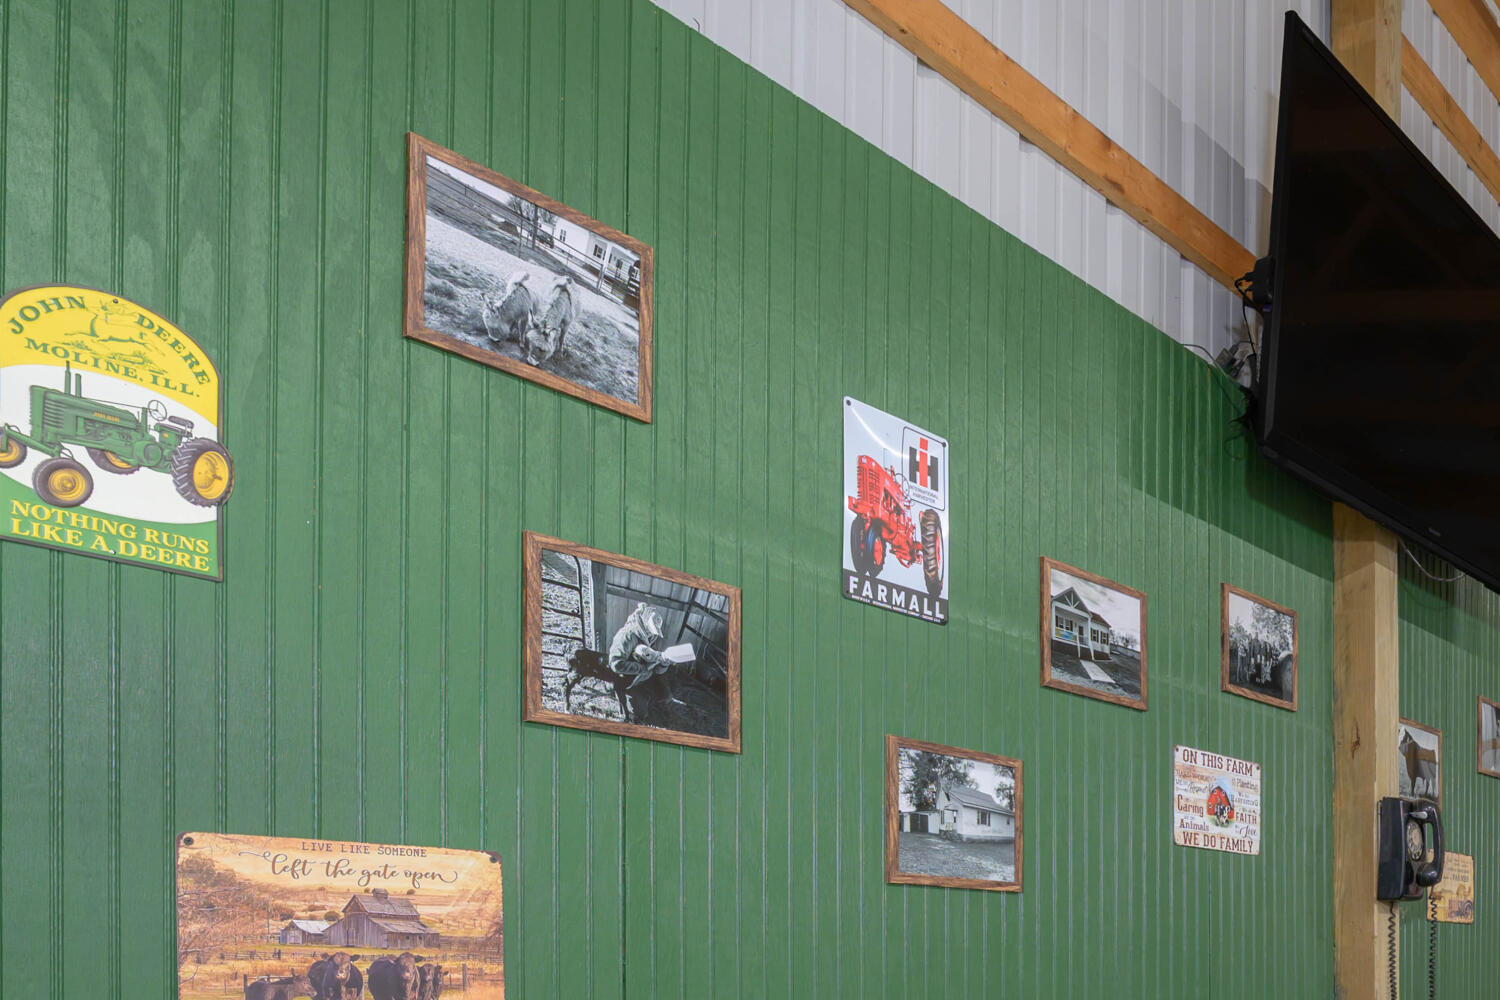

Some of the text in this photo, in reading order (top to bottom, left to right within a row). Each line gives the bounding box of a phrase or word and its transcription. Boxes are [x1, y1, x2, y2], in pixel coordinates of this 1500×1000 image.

[8, 296, 211, 386] JOHN DEERE
[150, 374, 200, 397] ILL.
[11, 499, 209, 554] NOTHING RUNS
[11, 518, 210, 572] LIKE A DEERE
[849, 576, 944, 619] FARMALL
[1183, 749, 1198, 764] ON
[1201, 752, 1223, 770] THIS
[1226, 758, 1253, 776] FARM
[1177, 794, 1204, 817] Caring
[1236, 811, 1257, 824] FAITH
[1180, 818, 1209, 831] Animals
[302, 842, 427, 857] LIVE LIKE SOMEONE
[1183, 831, 1253, 853] WE DO FAMILY
[262, 851, 456, 889] left the gate open
